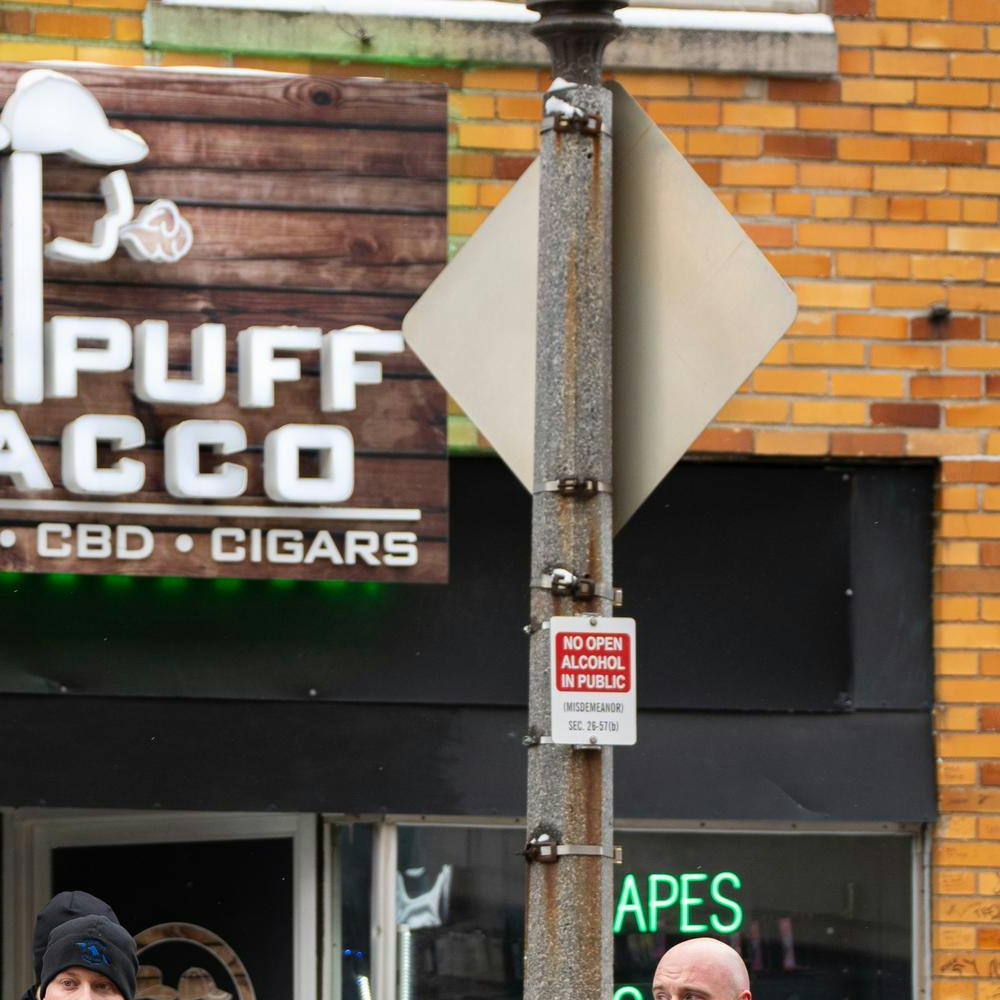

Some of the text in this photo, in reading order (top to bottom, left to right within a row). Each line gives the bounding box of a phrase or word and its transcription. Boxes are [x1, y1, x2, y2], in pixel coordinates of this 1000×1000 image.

[44, 314, 405, 412] PUFF
[36, 524, 155, 561] CBD
[210, 528, 419, 567] CIGARS
[563, 636, 623, 651] NO OPEN
[561, 655, 626, 670] ALCOHOL
[561, 674, 626, 689] IN PUBLIC
[563, 701, 624, 713] (MISDEMEANOR)
[568, 720, 620, 732] SEC. 26-57(b)
[613, 871, 744, 934] APES
